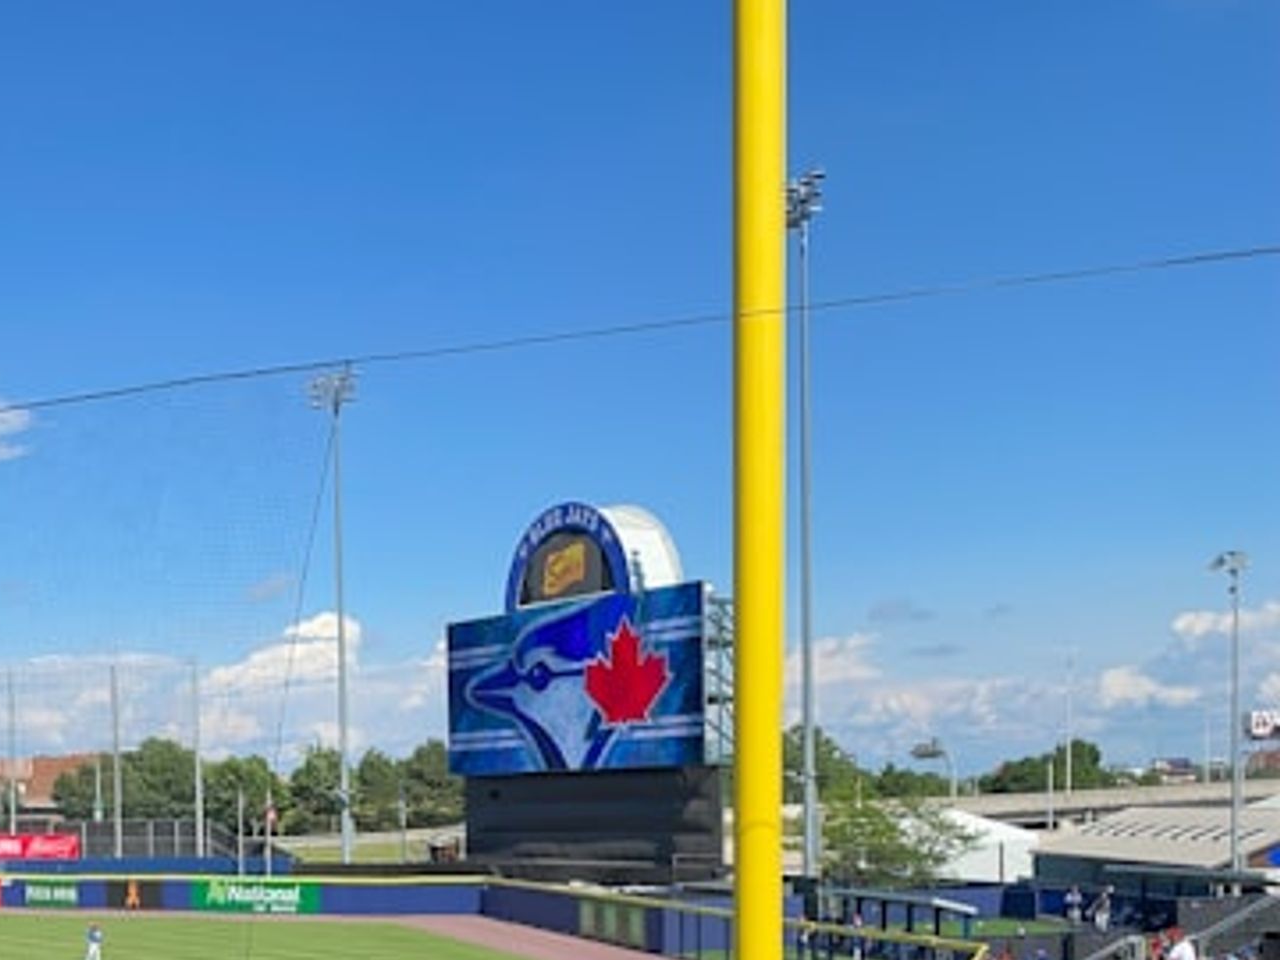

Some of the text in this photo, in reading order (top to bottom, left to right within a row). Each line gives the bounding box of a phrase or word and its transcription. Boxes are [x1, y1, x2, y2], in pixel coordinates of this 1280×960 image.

[529, 504, 599, 546] BLUE JAYS
[227, 884, 300, 903] National
